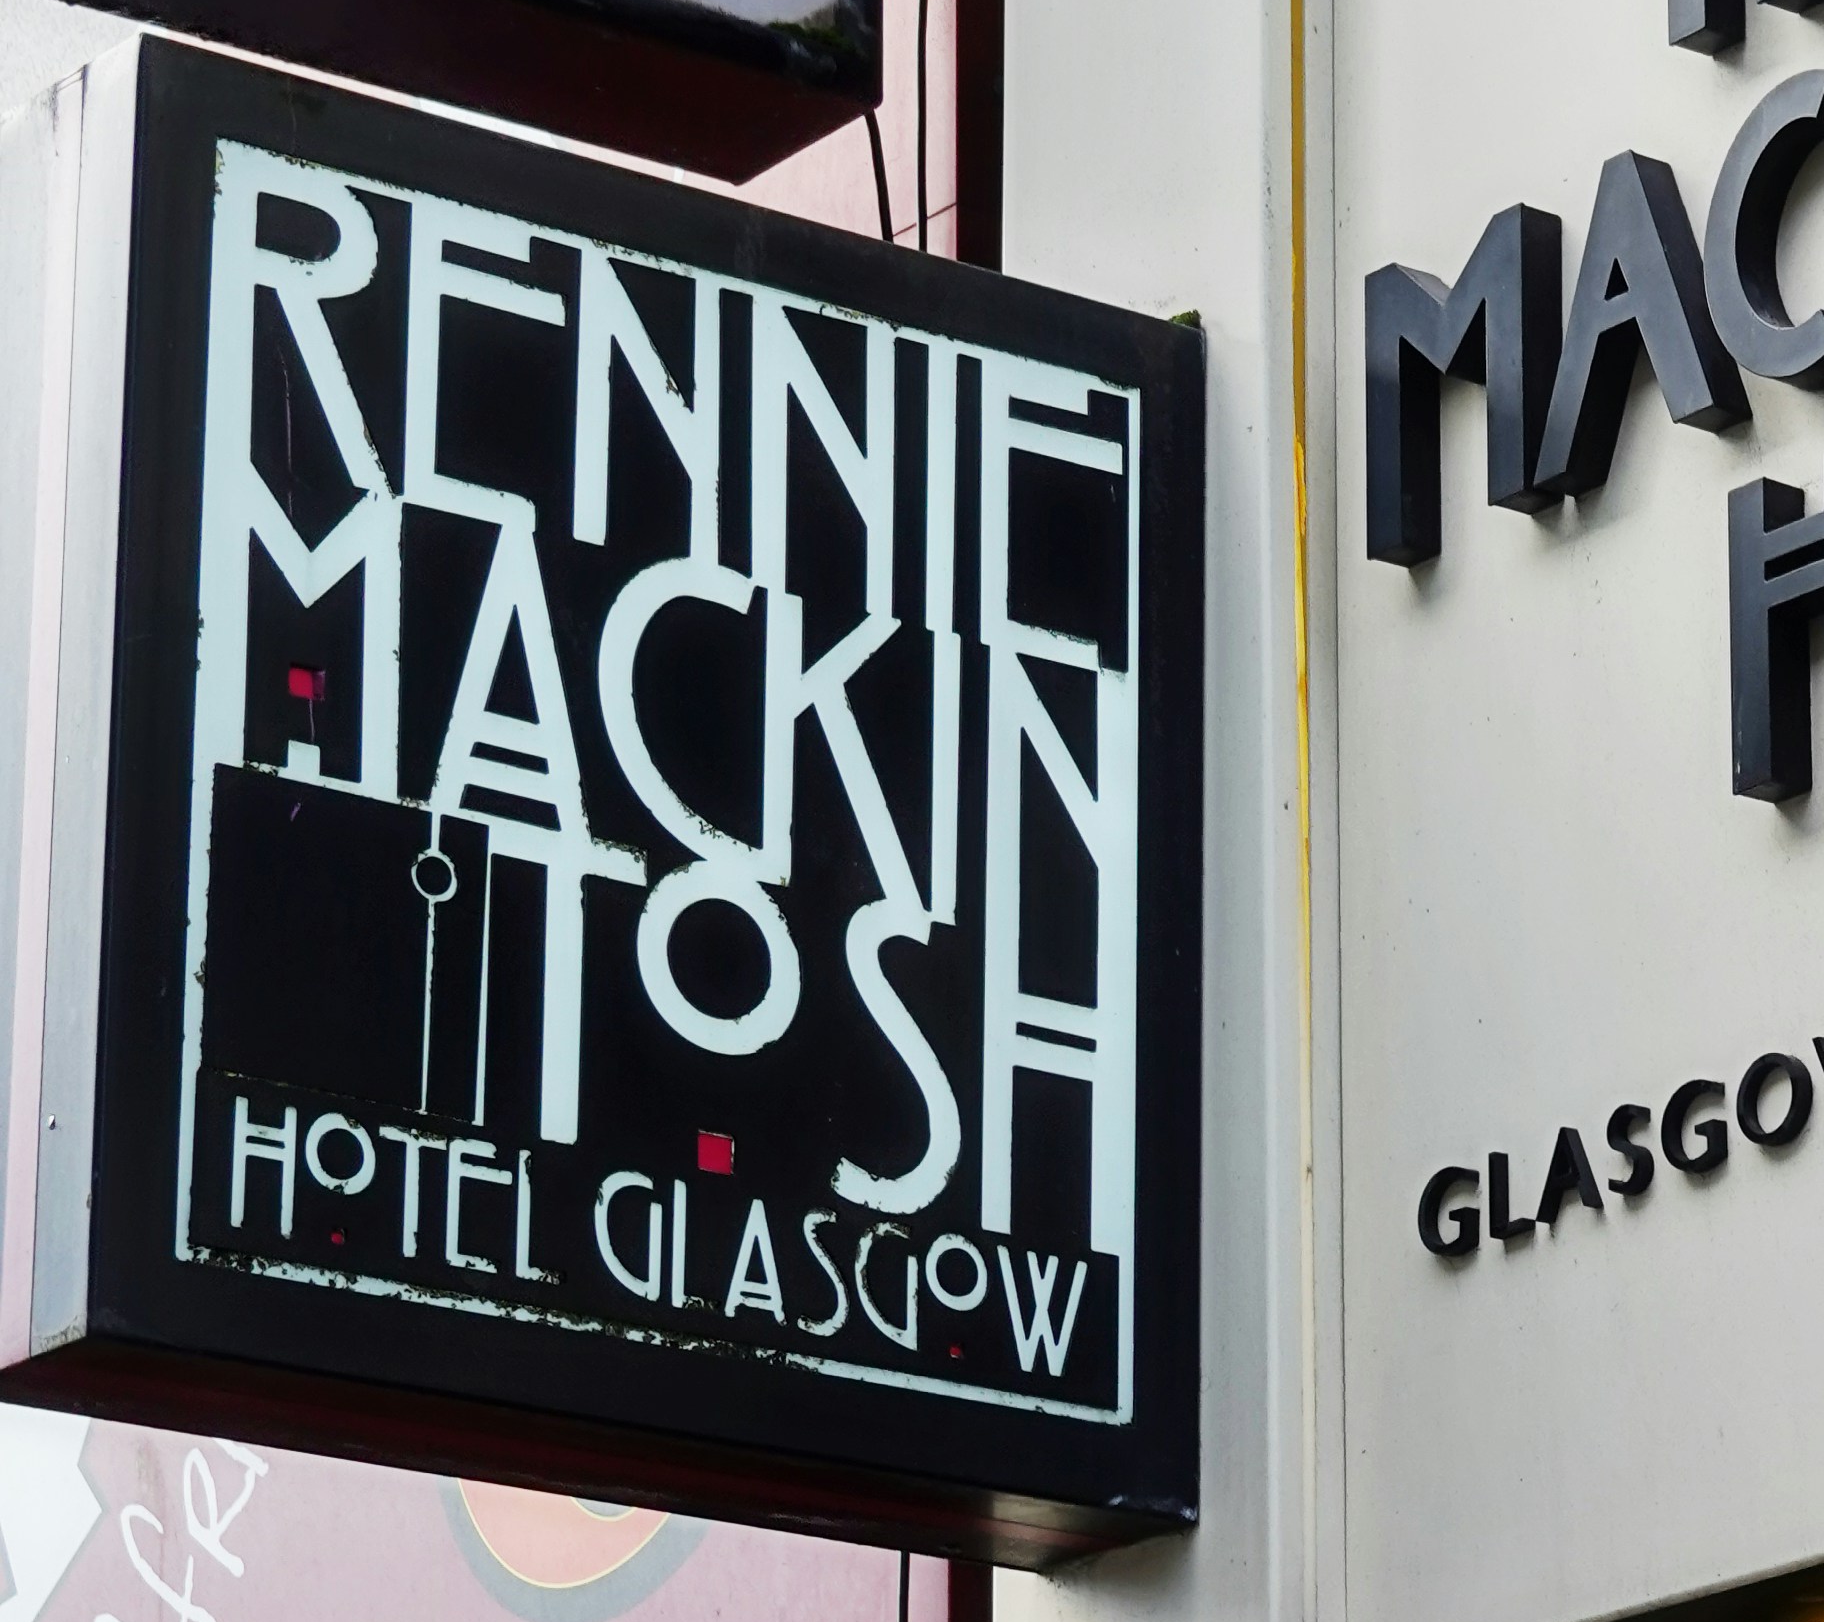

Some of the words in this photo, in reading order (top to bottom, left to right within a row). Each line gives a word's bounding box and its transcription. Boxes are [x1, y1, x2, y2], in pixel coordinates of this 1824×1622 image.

[212, 137, 1140, 671] RENNIE
[192, 459, 1138, 927] MACKIN
[231, 1096, 566, 1285] HOTEL
[594, 1171, 1088, 1377] GLASGOW
[485, 819, 1136, 1253] TOSH
